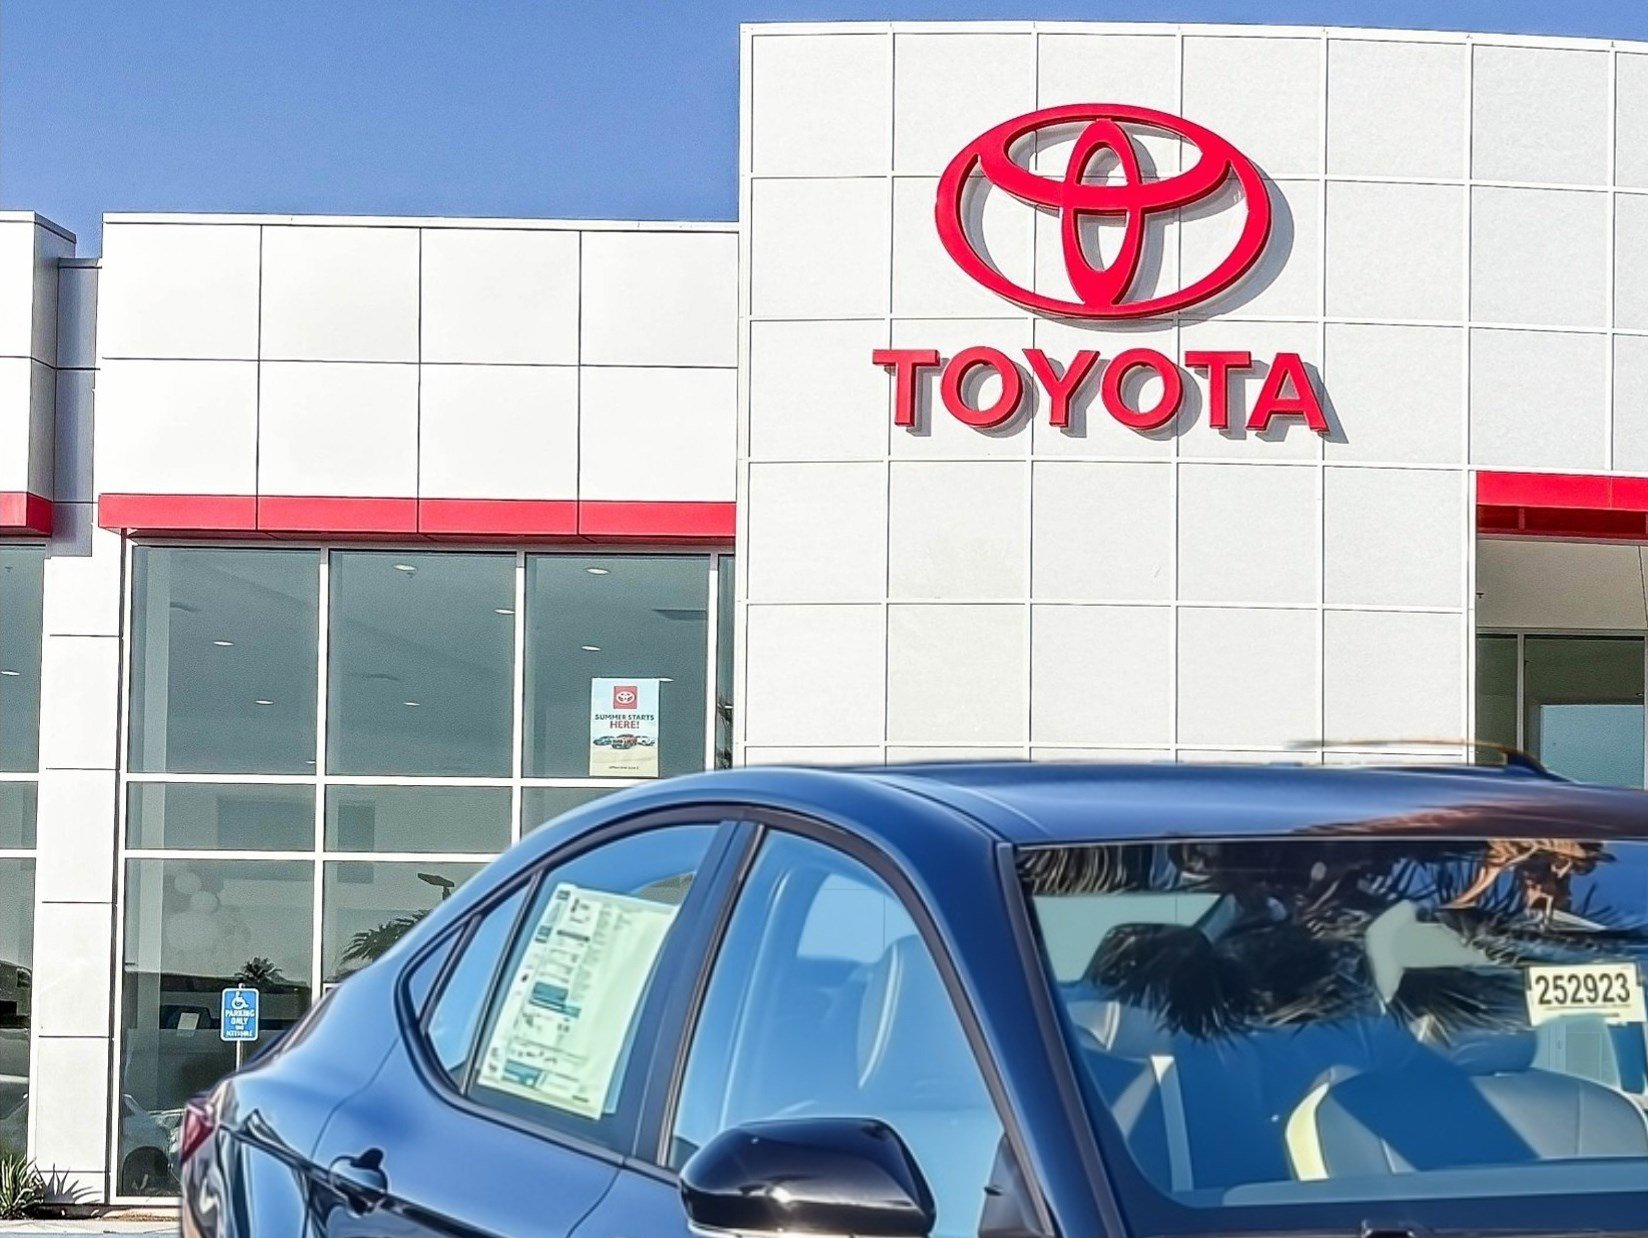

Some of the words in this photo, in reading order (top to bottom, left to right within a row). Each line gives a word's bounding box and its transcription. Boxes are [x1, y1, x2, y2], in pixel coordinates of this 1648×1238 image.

[873, 345, 1330, 432] TOYOTA
[609, 720, 640, 729] HERE!
[1535, 973, 1630, 1005] 252923
[225, 1009, 255, 1017] PARKING
